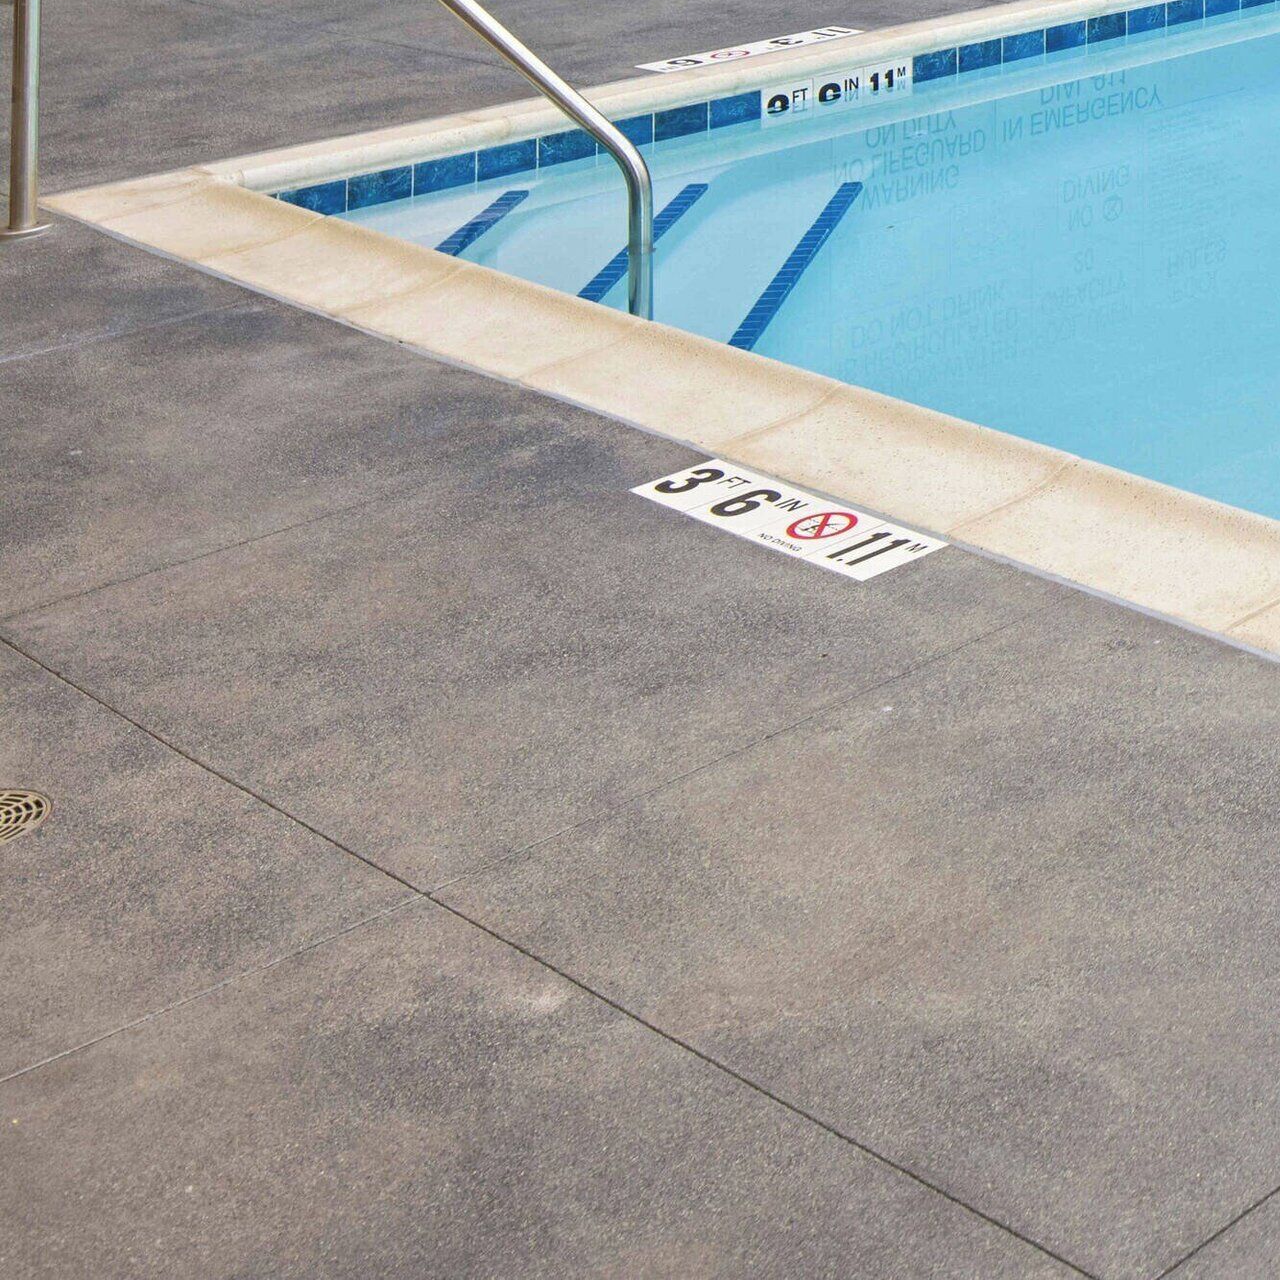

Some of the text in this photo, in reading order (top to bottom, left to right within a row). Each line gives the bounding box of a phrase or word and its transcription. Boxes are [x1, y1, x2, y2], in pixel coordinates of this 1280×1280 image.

[792, 87, 808, 104] FT
[844, 76, 859, 92] IN
[897, 66, 906, 77] M
[654, 468, 725, 494] 3
[718, 475, 751, 490] FT
[710, 489, 782, 518] 6
[776, 498, 808, 513] IN
[905, 542, 928, 554] M
